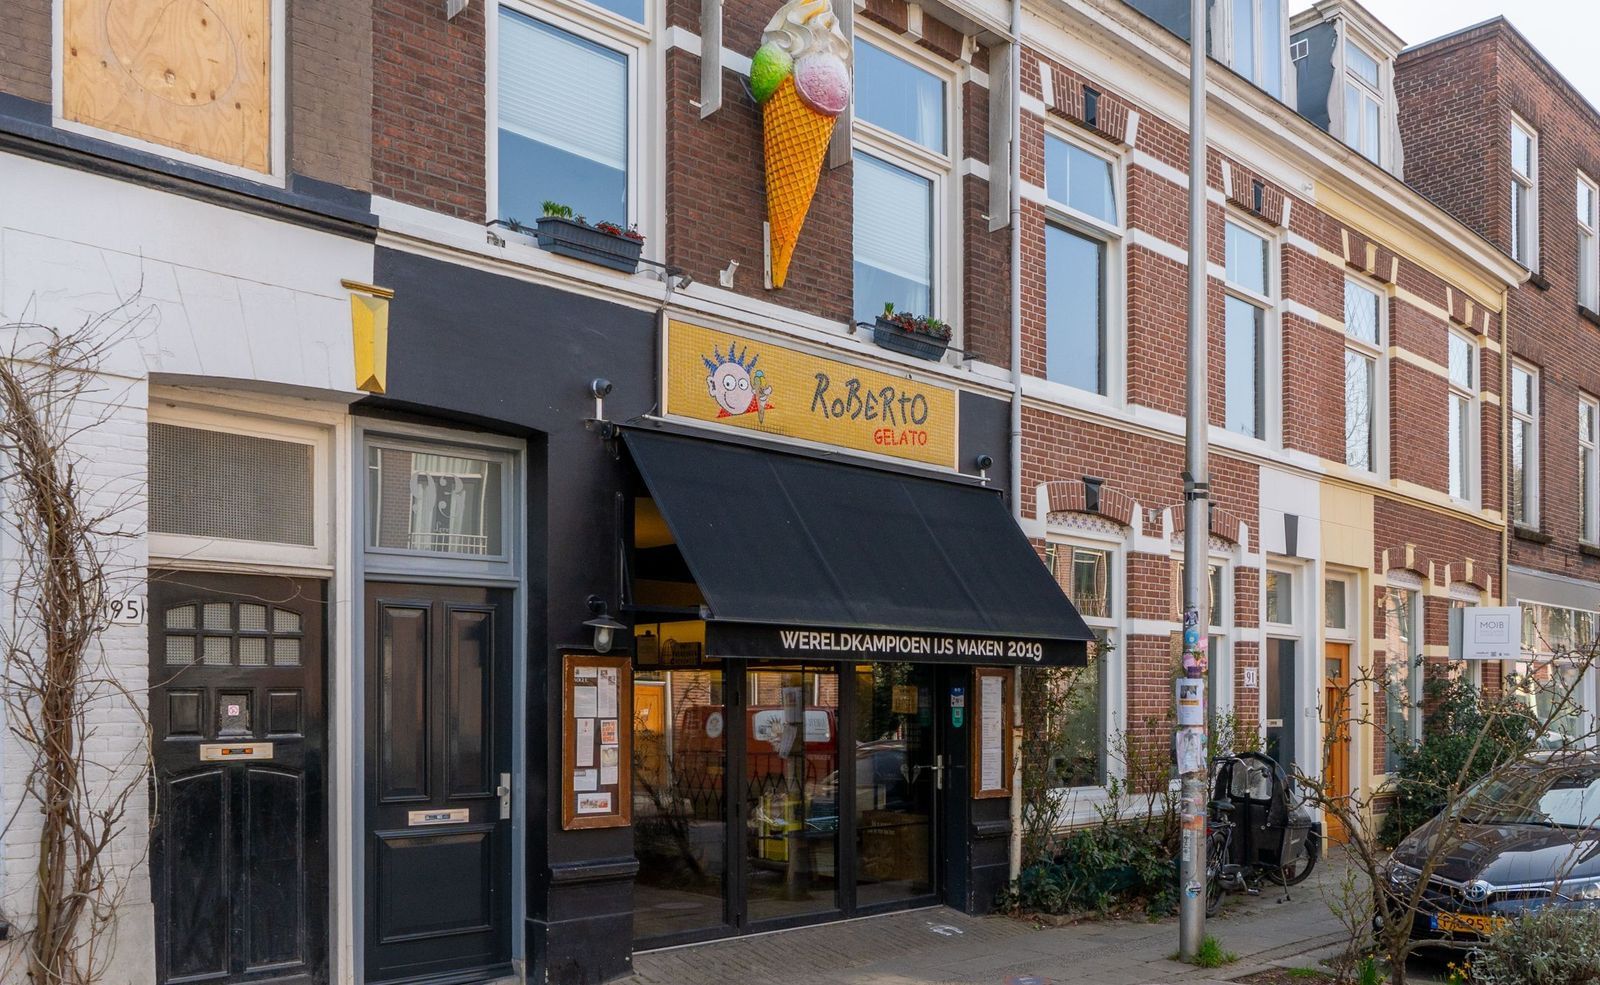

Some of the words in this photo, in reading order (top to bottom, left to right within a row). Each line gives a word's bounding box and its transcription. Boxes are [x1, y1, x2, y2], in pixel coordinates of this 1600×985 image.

[873, 428, 928, 446] GELATO
[110, 600, 139, 619] 95
[1480, 621, 1504, 629] MOIB
[780, 630, 931, 655] WERELDKAMPIOEN
[934, 637, 954, 655] IJS
[956, 638, 1004, 657] MAKEN
[1007, 641, 1043, 662] 2019
[1246, 671, 1255, 684] 91
